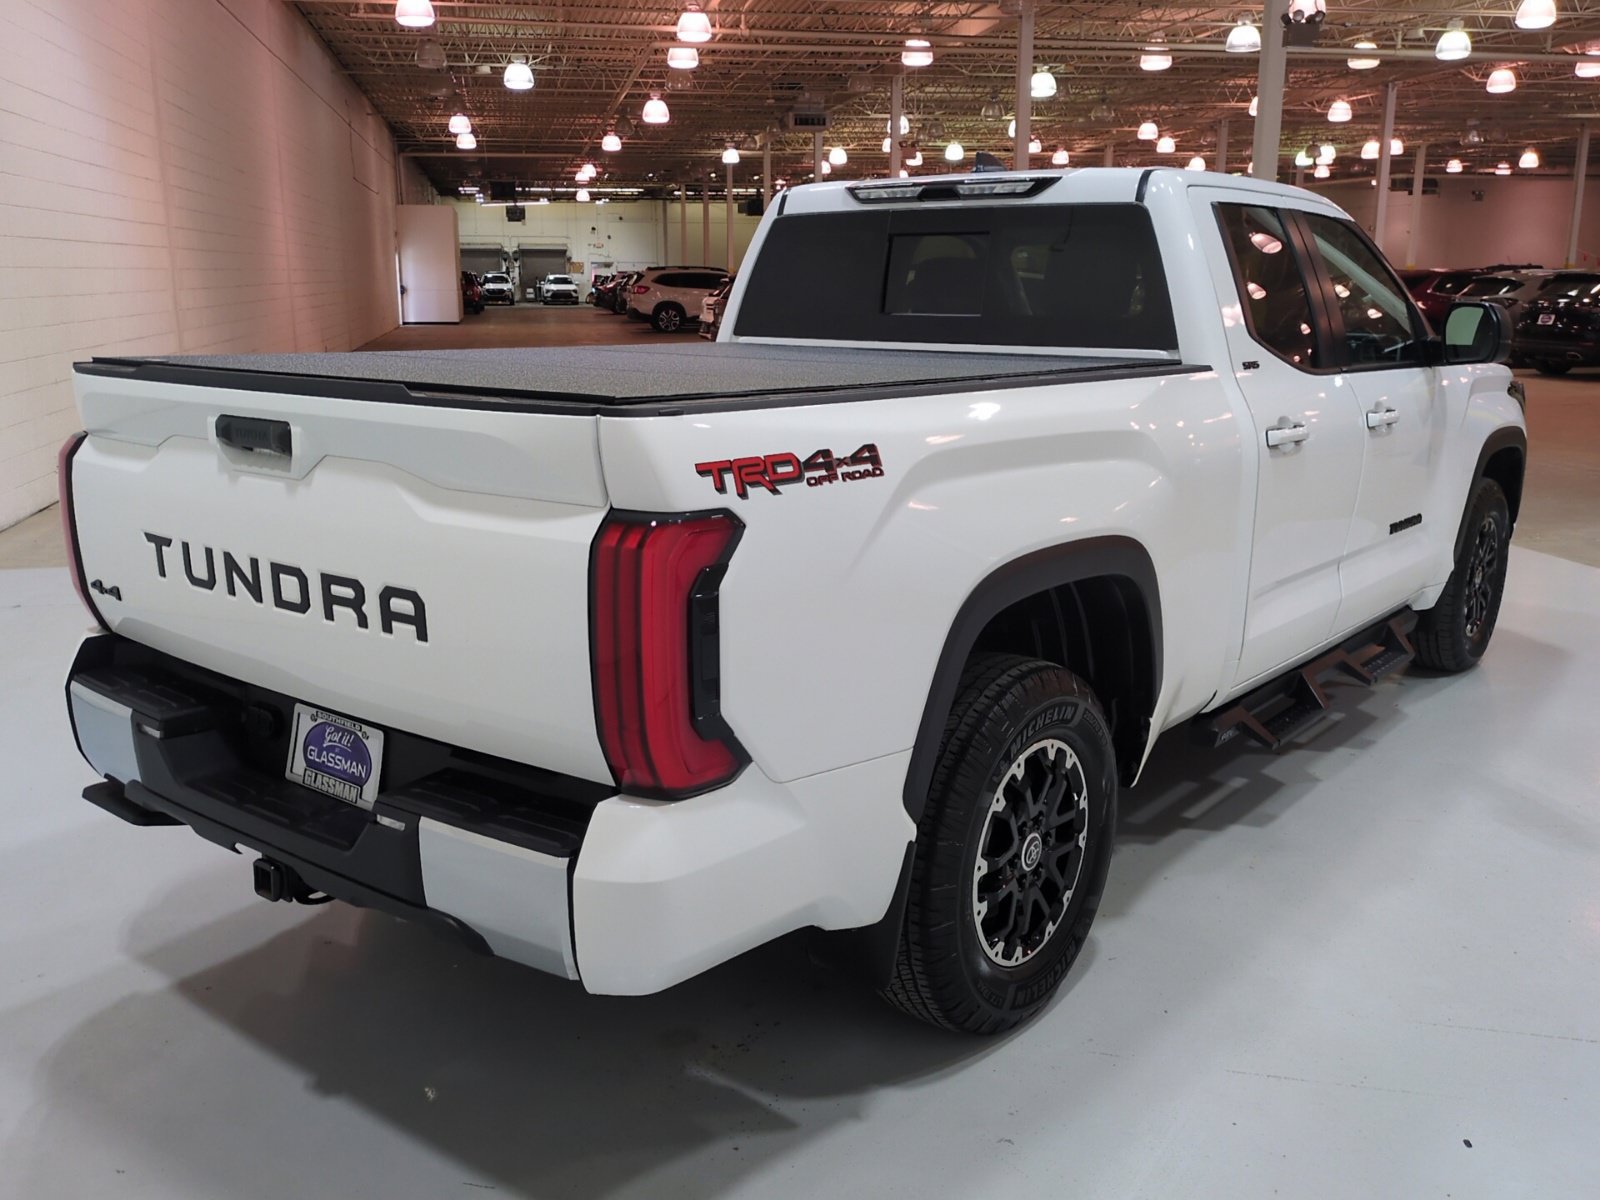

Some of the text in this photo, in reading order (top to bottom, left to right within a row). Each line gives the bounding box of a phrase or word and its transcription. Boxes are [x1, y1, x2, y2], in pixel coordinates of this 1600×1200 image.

[695, 443, 883, 500] TRD 4x4
[806, 467, 885, 487] OFF ROAD
[143, 531, 429, 643] TUNDRA
[317, 711, 361, 731] SOUTHFIELD
[325, 726, 355, 747] Got it!
[1010, 705, 1075, 761] MICHELIN
[307, 746, 366, 779] GLASSMAN
[304, 771, 358, 803] GLASSMAN
